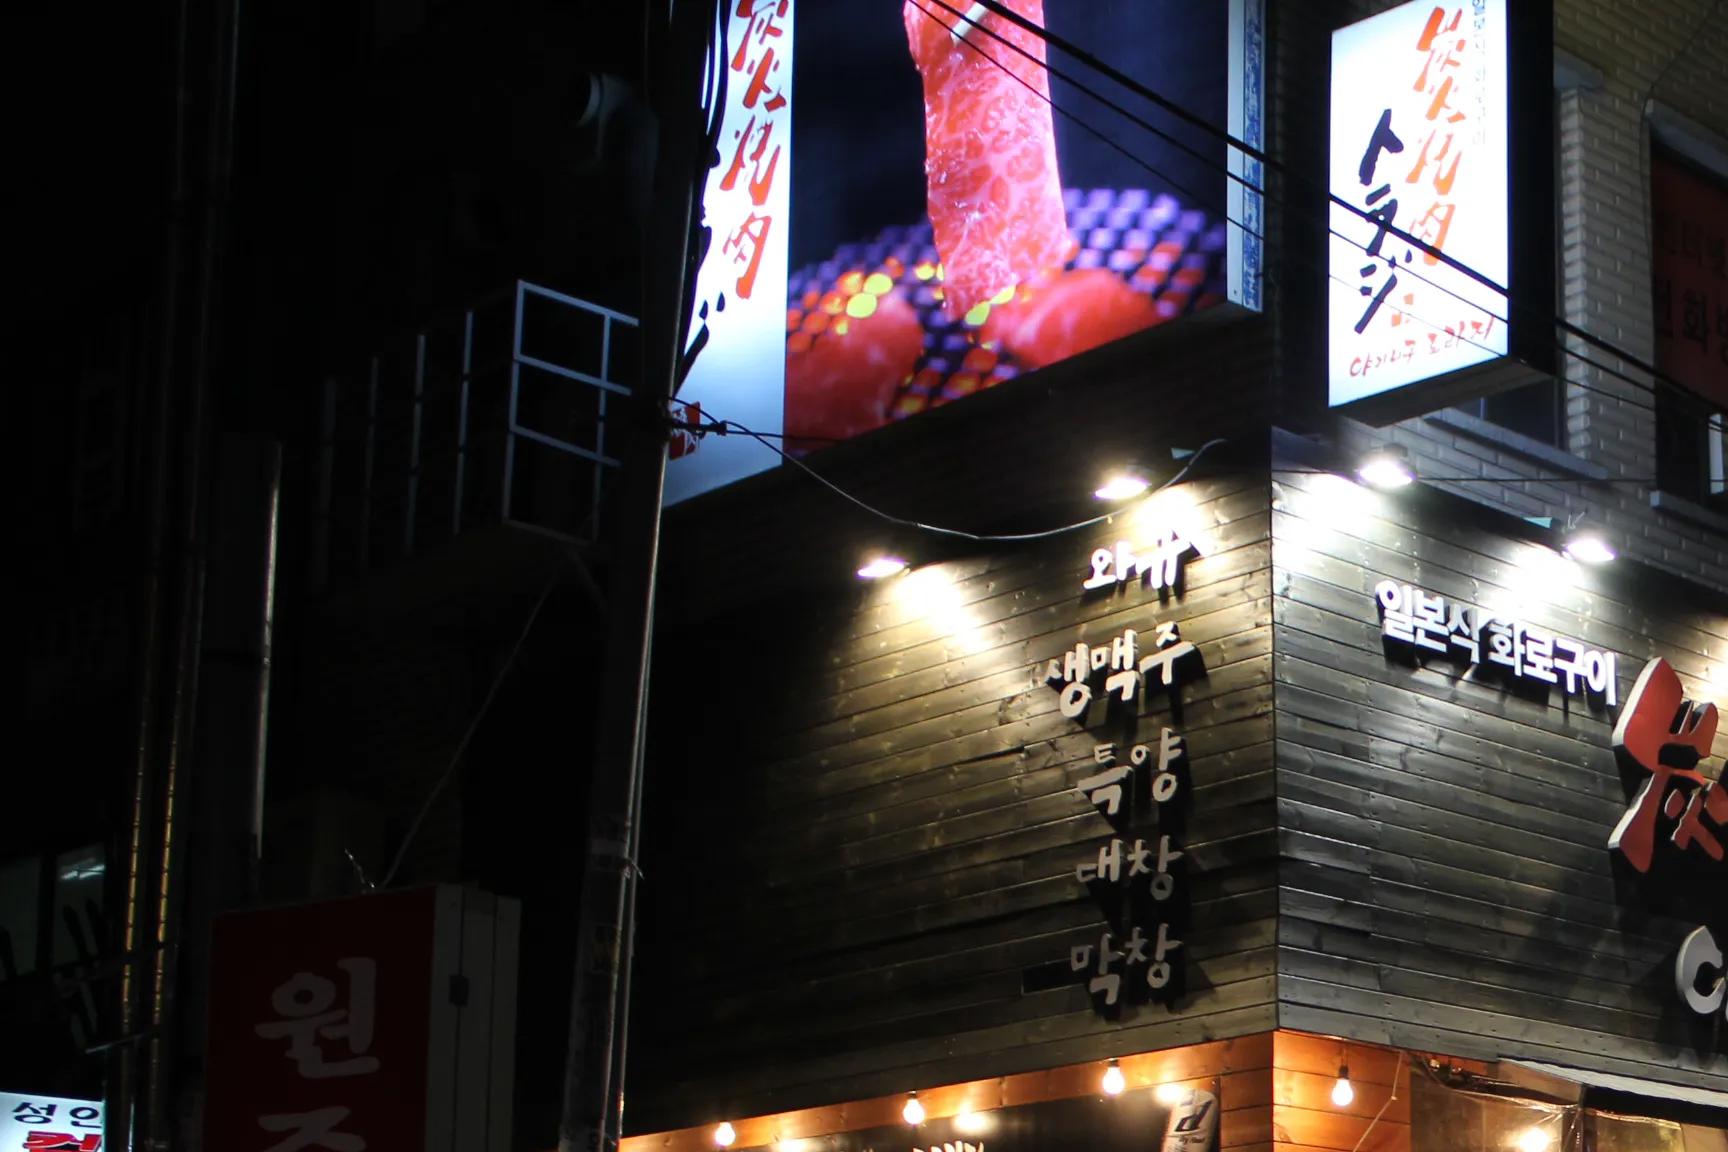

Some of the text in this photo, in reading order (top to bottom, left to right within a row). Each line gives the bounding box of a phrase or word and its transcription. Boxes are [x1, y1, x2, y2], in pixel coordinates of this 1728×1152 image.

[1045, 621, 1195, 718] 생맥주
[1374, 579, 1618, 707] 일본식 화로구이
[1077, 727, 1182, 815] 특양
[1076, 834, 1183, 901] 대창
[1071, 922, 1184, 1005] 막창
